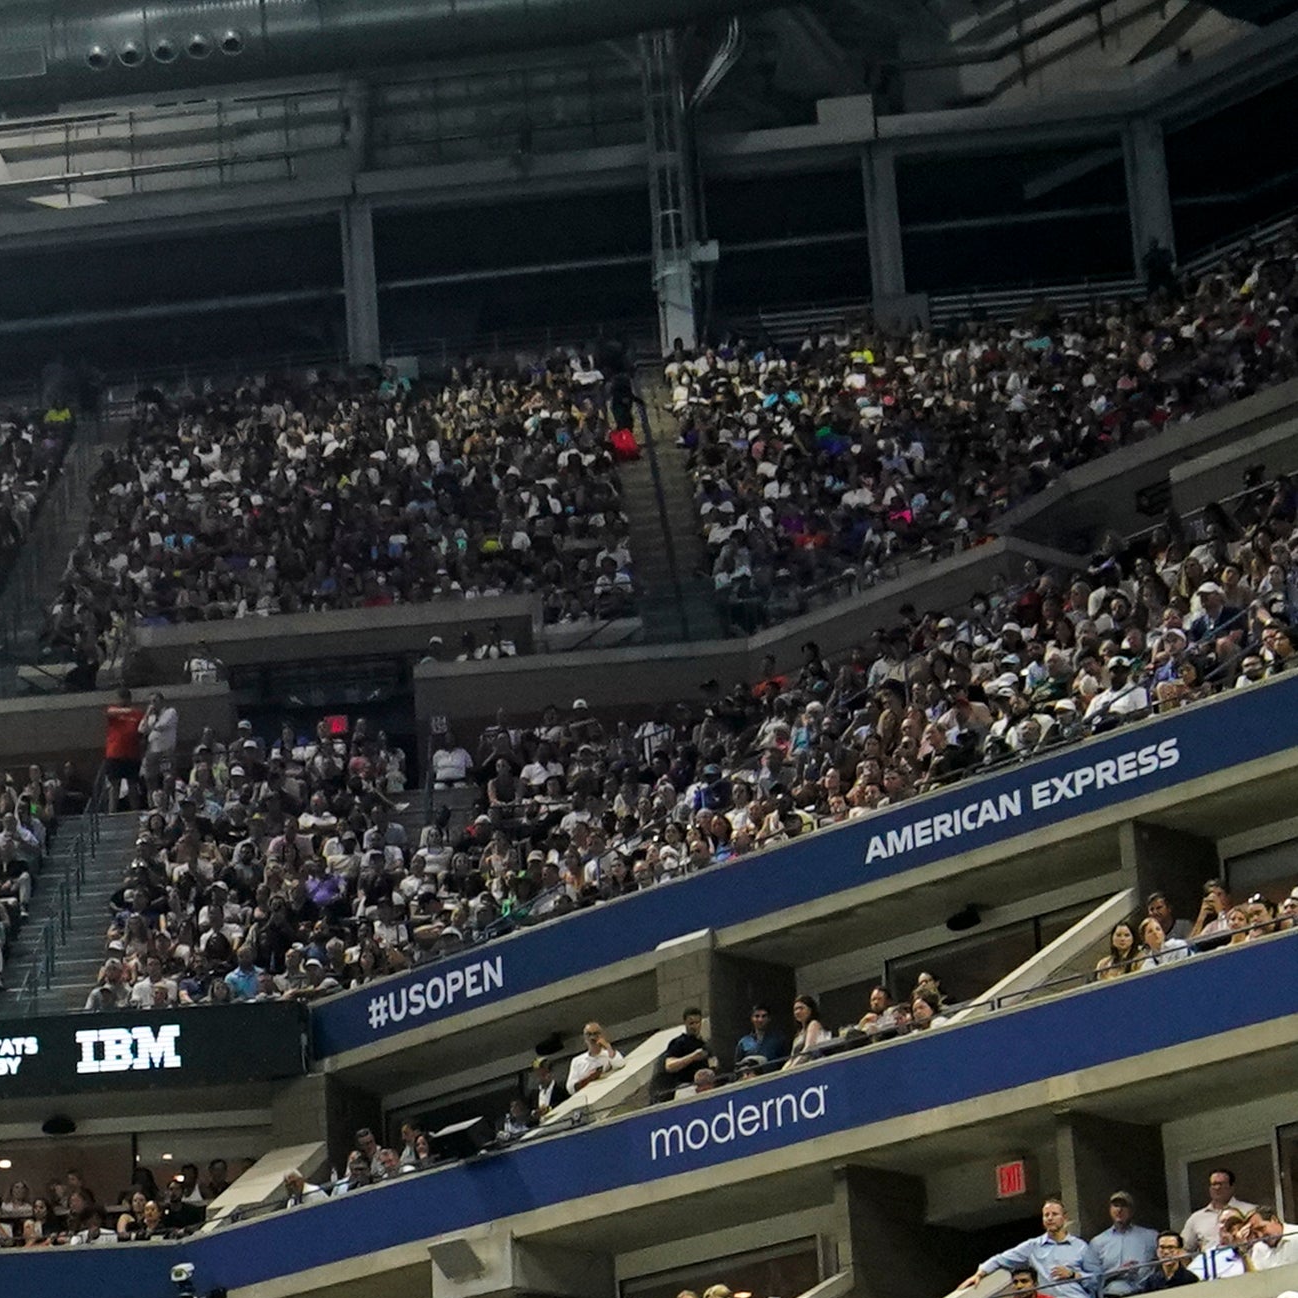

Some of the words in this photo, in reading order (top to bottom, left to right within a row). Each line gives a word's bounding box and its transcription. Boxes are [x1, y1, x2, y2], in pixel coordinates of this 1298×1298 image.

[865, 789, 1023, 865] AMERICAN
[1030, 738, 1181, 811] EXPRESS
[368, 955, 504, 1030] #USOPEN
[75, 1024, 182, 1074] IBM
[650, 1084, 826, 1161] moderna
